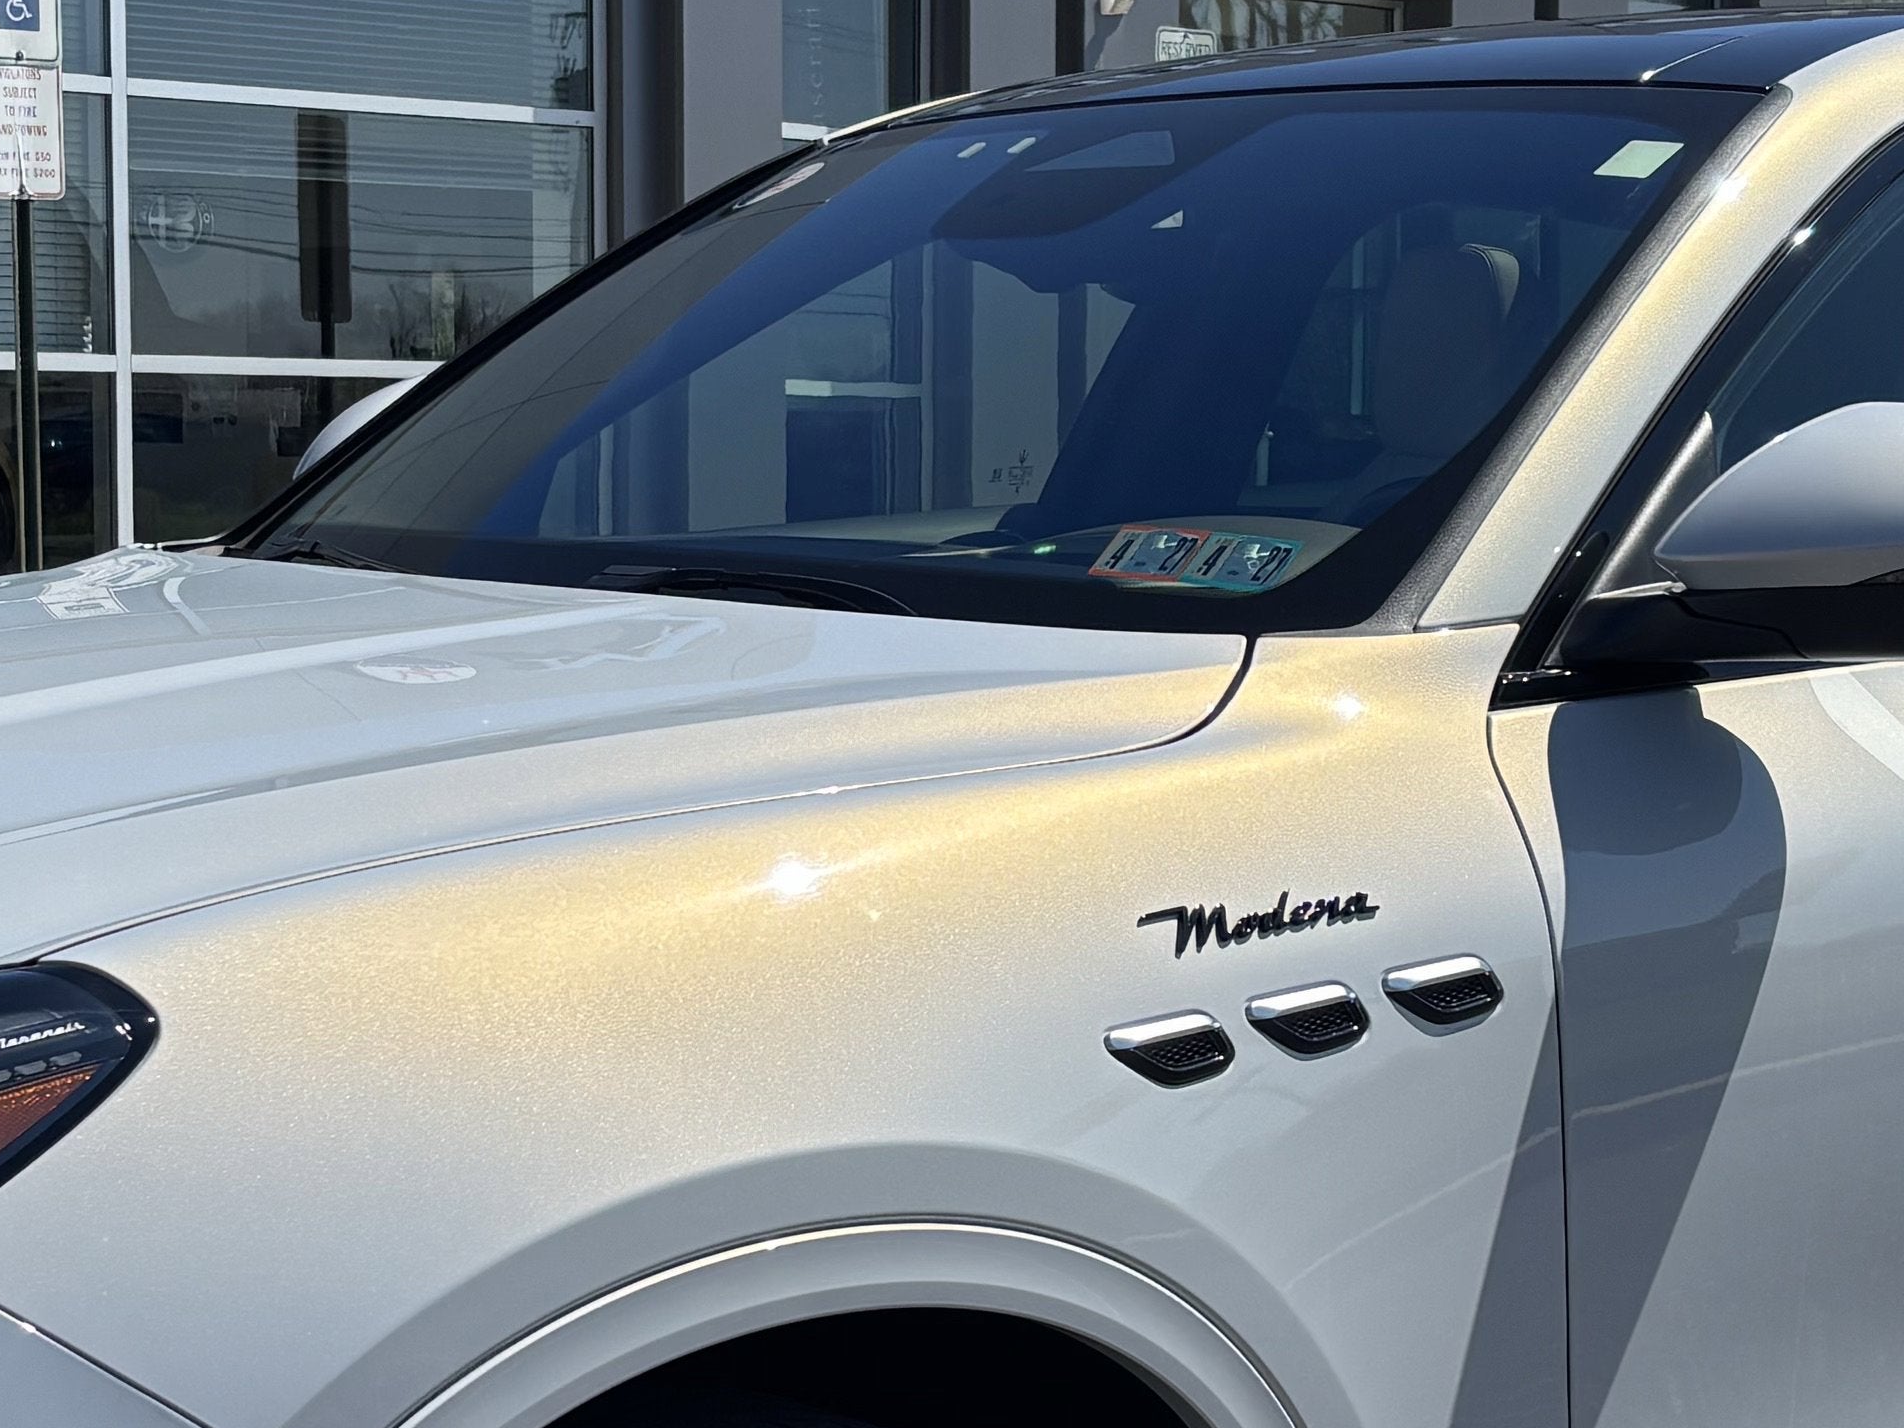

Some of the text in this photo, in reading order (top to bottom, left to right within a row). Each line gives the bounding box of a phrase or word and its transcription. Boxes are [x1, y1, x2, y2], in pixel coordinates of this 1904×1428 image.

[2, 87, 37, 99] SUBJECT
[5, 105, 15, 116] TO
[1104, 537, 1200, 575] 4 27
[1197, 545, 1293, 586] 4 27
[1137, 888, 1381, 960] Modena
